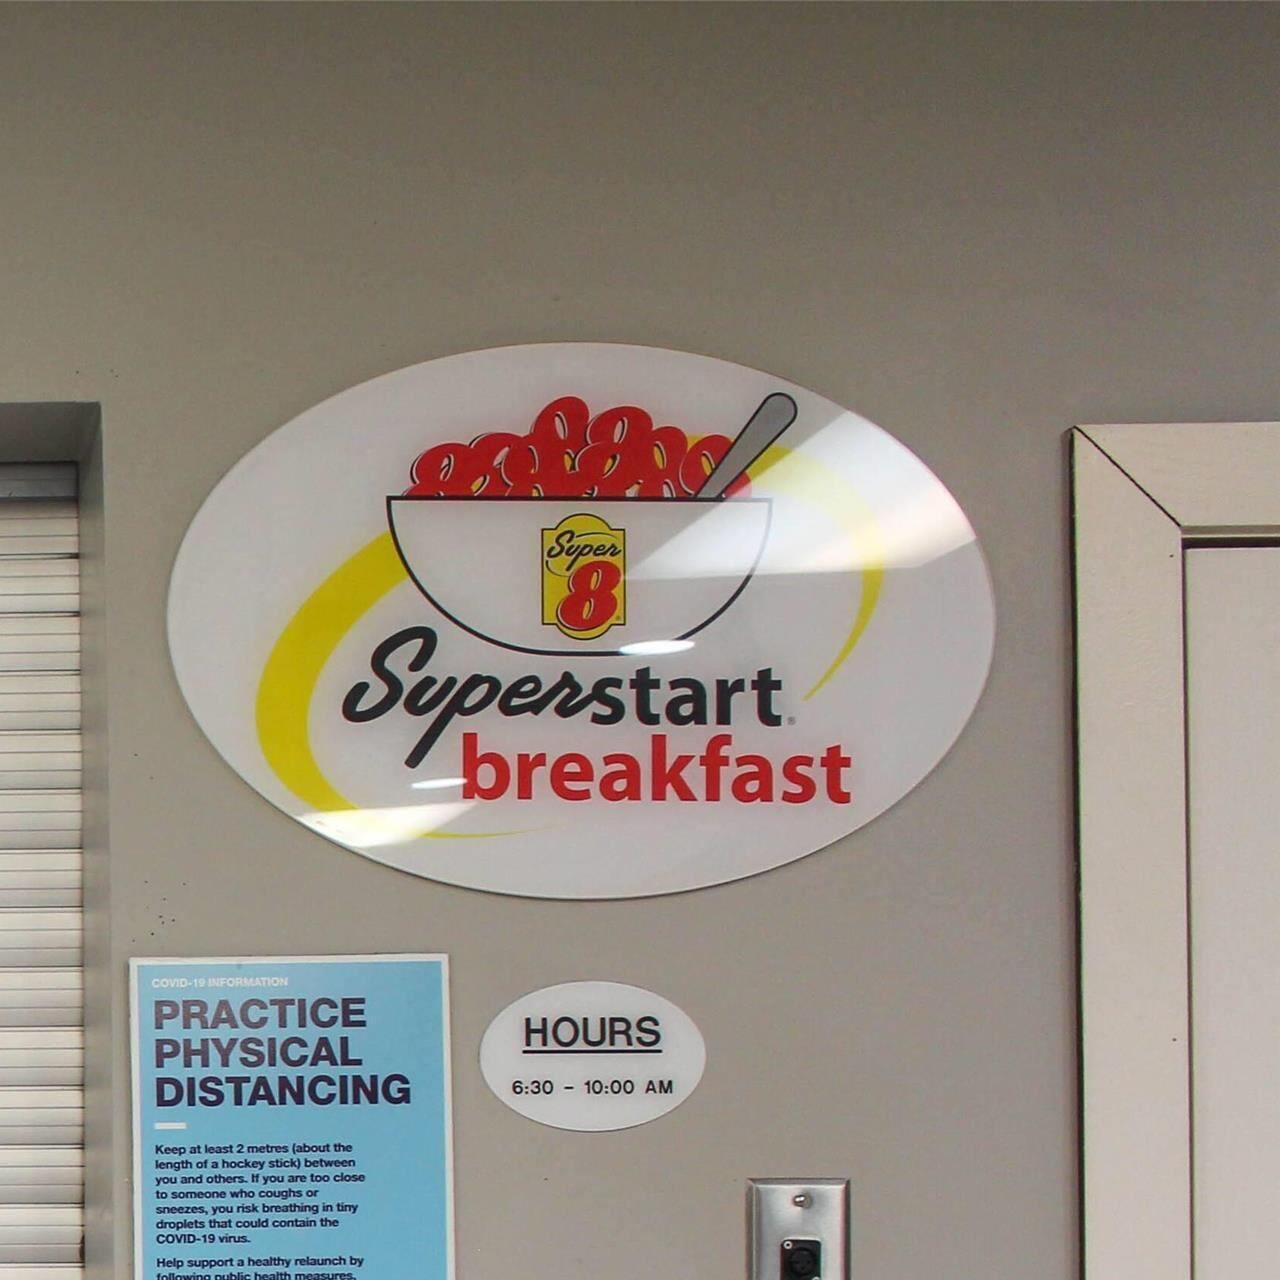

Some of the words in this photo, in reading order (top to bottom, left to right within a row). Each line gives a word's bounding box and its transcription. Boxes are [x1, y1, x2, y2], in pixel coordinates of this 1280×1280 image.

[546, 529, 622, 572] Super
[556, 560, 622, 631] 8
[462, 733, 852, 805] breakfast
[151, 978, 205, 988] COVID-19
[207, 977, 288, 988] INFORMATION
[154, 997, 366, 1030] PRACTICE
[525, 1016, 661, 1047] HOURS
[155, 1036, 362, 1068] PHYSICAL
[155, 1074, 412, 1107] DISTANCING
[512, 1080, 554, 1095] 6:30
[584, 1080, 635, 1095] 10:00
[645, 1080, 673, 1094] AM
[155, 1144, 185, 1156] Keep
[190, 1144, 202, 1154] at
[204, 1143, 233, 1154] least
[236, 1143, 244, 1153] 2
[247, 1143, 289, 1153] metres
[292, 1142, 330, 1155] (about
[333, 1142, 352, 1152] the
[155, 1159, 192, 1171] length
[196, 1158, 208, 1168] of
[212, 1160, 219, 1168] a
[222, 1158, 265, 1170] hockey
[268, 1157, 301, 1170] stick)
[304, 1157, 356, 1167] between
[155, 1175, 178, 1186] you
[181, 1173, 202, 1183] and
[207, 1173, 248, 1183] others.
[251, 1172, 259, 1183] If
[262, 1174, 284, 1184] you
[288, 1174, 306, 1182] are
[310, 1172, 330, 1182] too
[333, 1171, 365, 1182] close
[156, 1189, 168, 1199] to
[171, 1190, 226, 1198] someone
[230, 1188, 255, 1198] who
[258, 1187, 303, 1200] coughs
[306, 1189, 319, 1197] or
[156, 1205, 208, 1215] sneezes,
[212, 1205, 234, 1215] you
[237, 1202, 259, 1213] risk
[262, 1202, 318, 1214] breathing
[322, 1202, 333, 1212] in
[337, 1201, 358, 1214] tiny
[156, 1218, 205, 1230] droplets
[209, 1217, 232, 1228] that
[236, 1217, 269, 1227] could
[272, 1217, 317, 1227] contain
[320, 1216, 339, 1226] the
[156, 1233, 215, 1243] COVID-19
[218, 1233, 251, 1243] virus.
[157, 1257, 184, 1269] Help
[187, 1256, 234, 1268] support
[238, 1258, 244, 1266] a
[248, 1256, 291, 1268] healthy
[294, 1255, 346, 1265] relaunch
[350, 1255, 364, 1267] by
[254, 1270, 291, 1280] health
